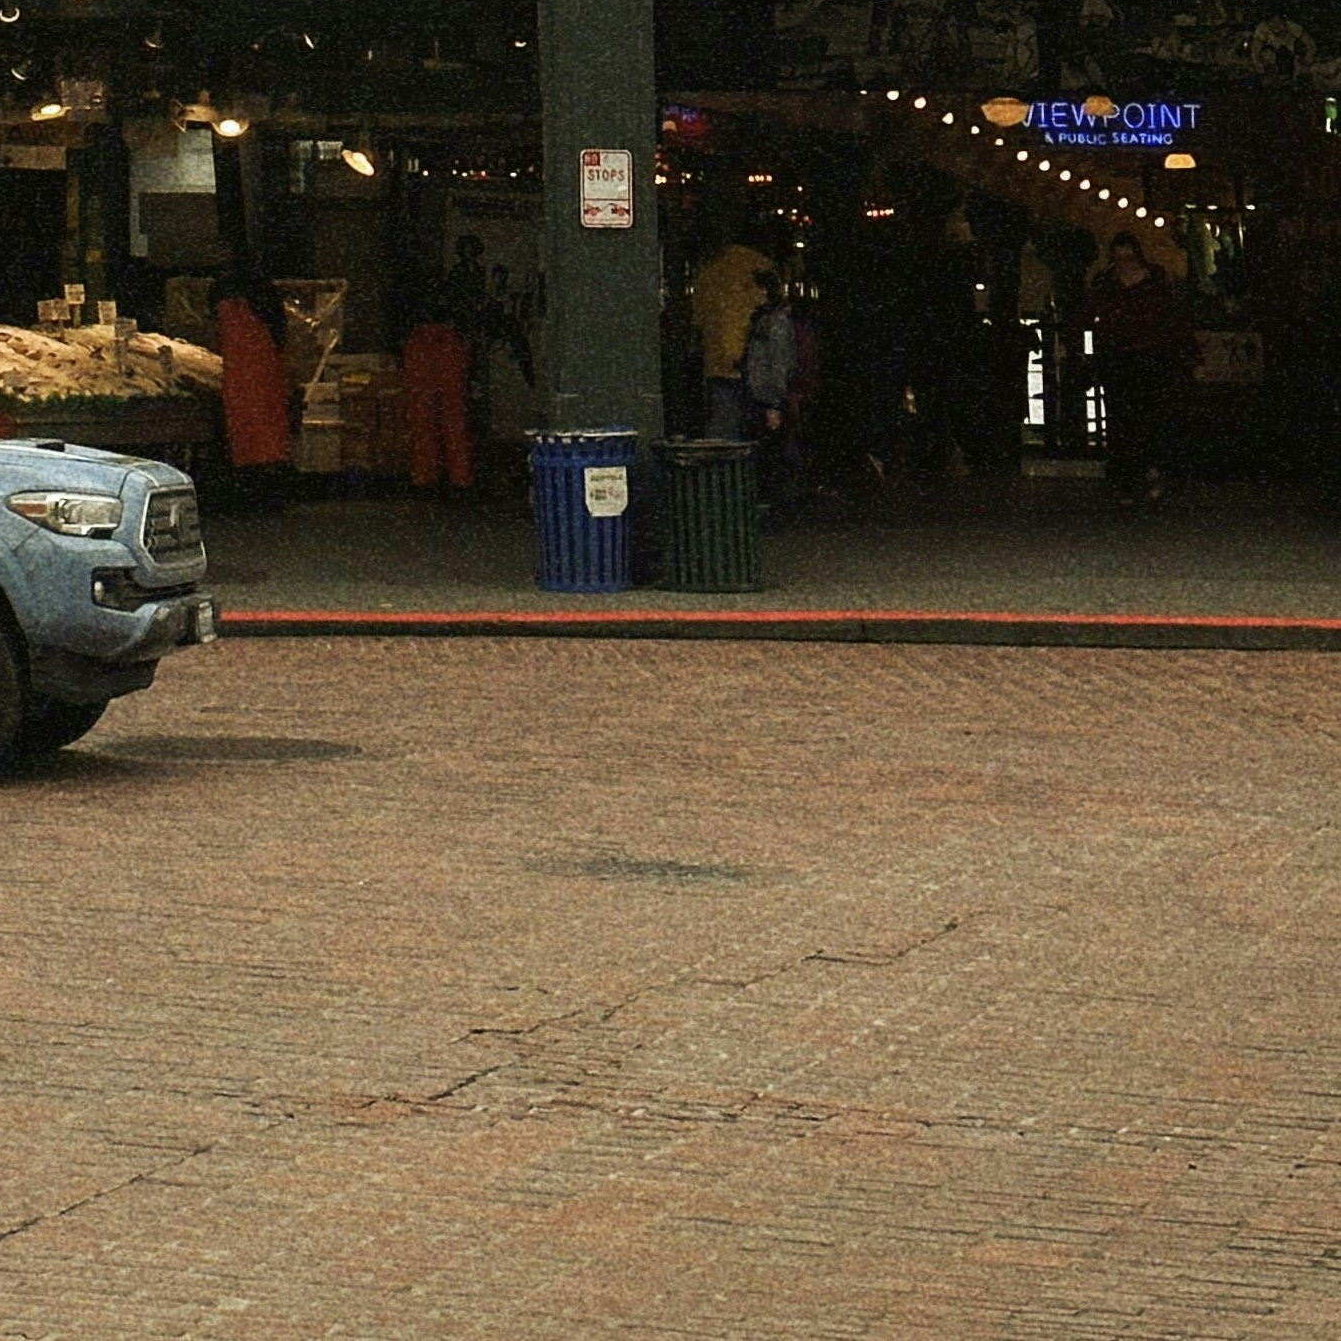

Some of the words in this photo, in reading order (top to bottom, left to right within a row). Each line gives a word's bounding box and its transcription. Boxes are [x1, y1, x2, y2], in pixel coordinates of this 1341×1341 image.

[1059, 132, 1108, 145] PUBLIC
[1112, 132, 1174, 145] SEATING
[587, 168, 625, 182] STOPS
